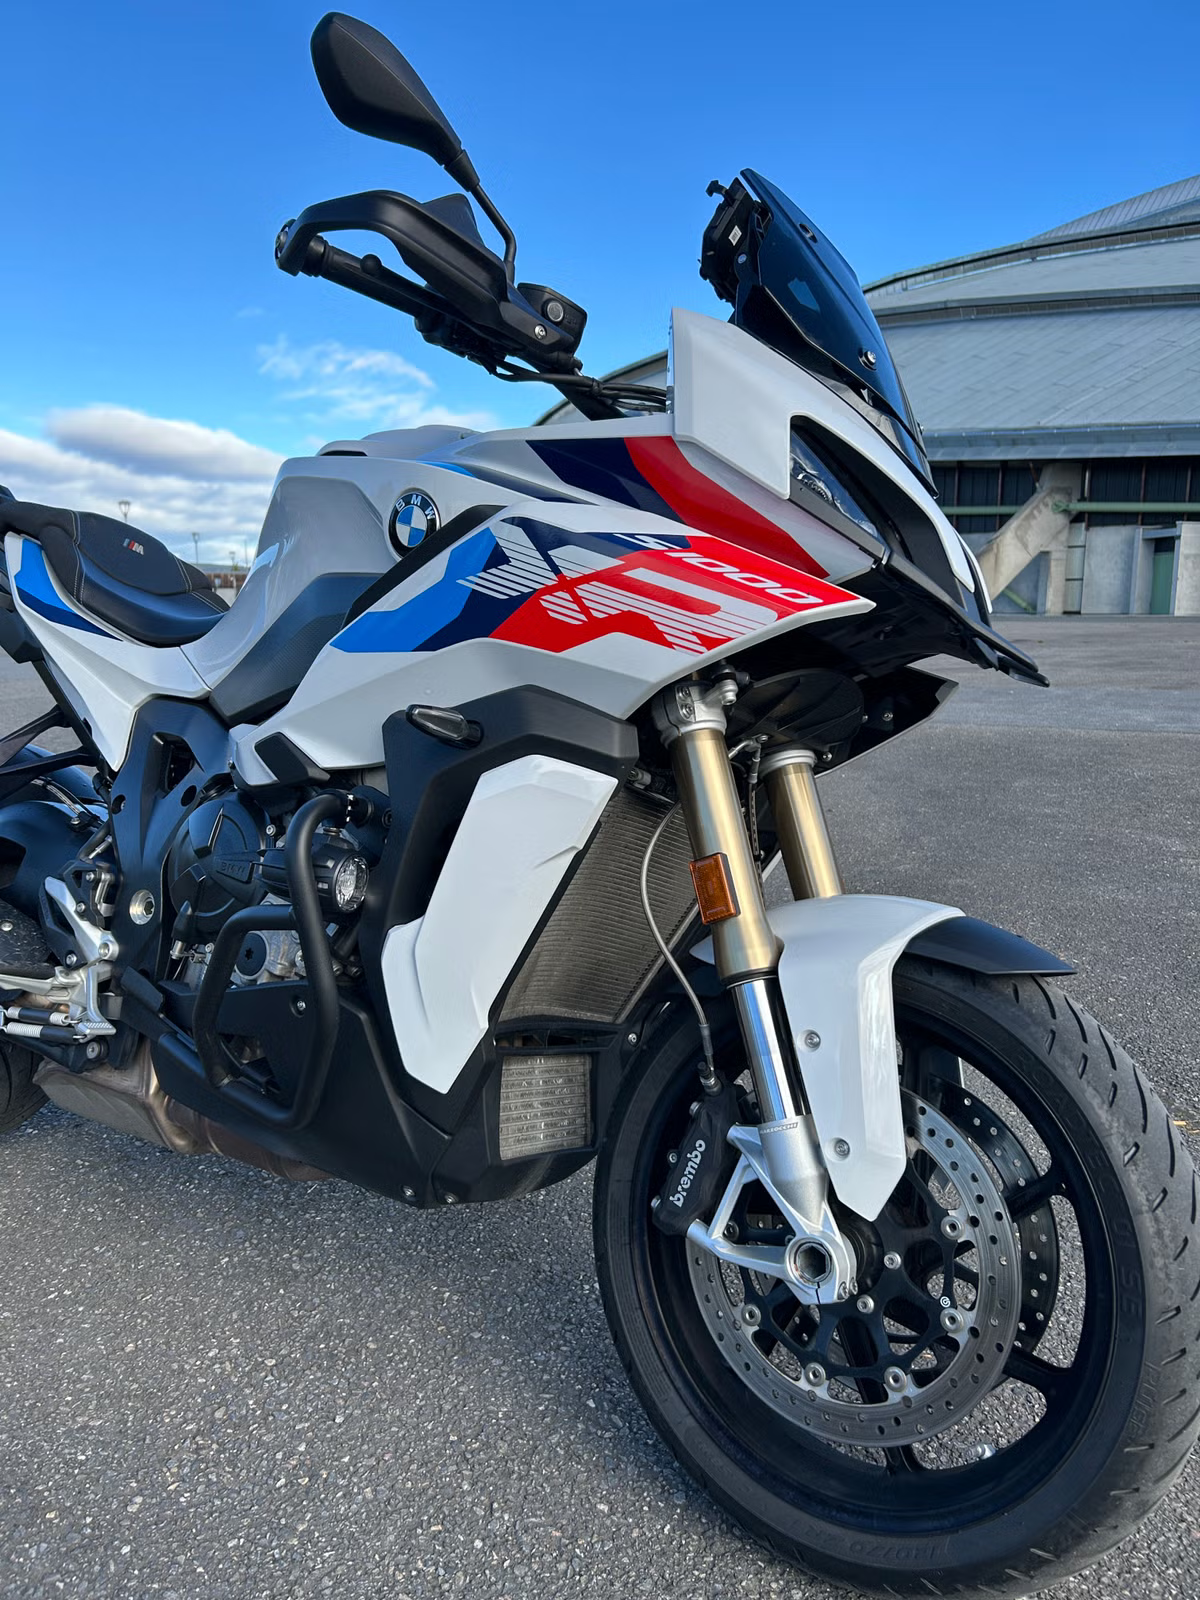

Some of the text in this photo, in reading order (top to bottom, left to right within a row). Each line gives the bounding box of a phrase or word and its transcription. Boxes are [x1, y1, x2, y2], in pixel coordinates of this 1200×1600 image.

[395, 494, 436, 520] BMW
[612, 533, 825, 604] S 1000
[669, 1139, 706, 1208] brembo
